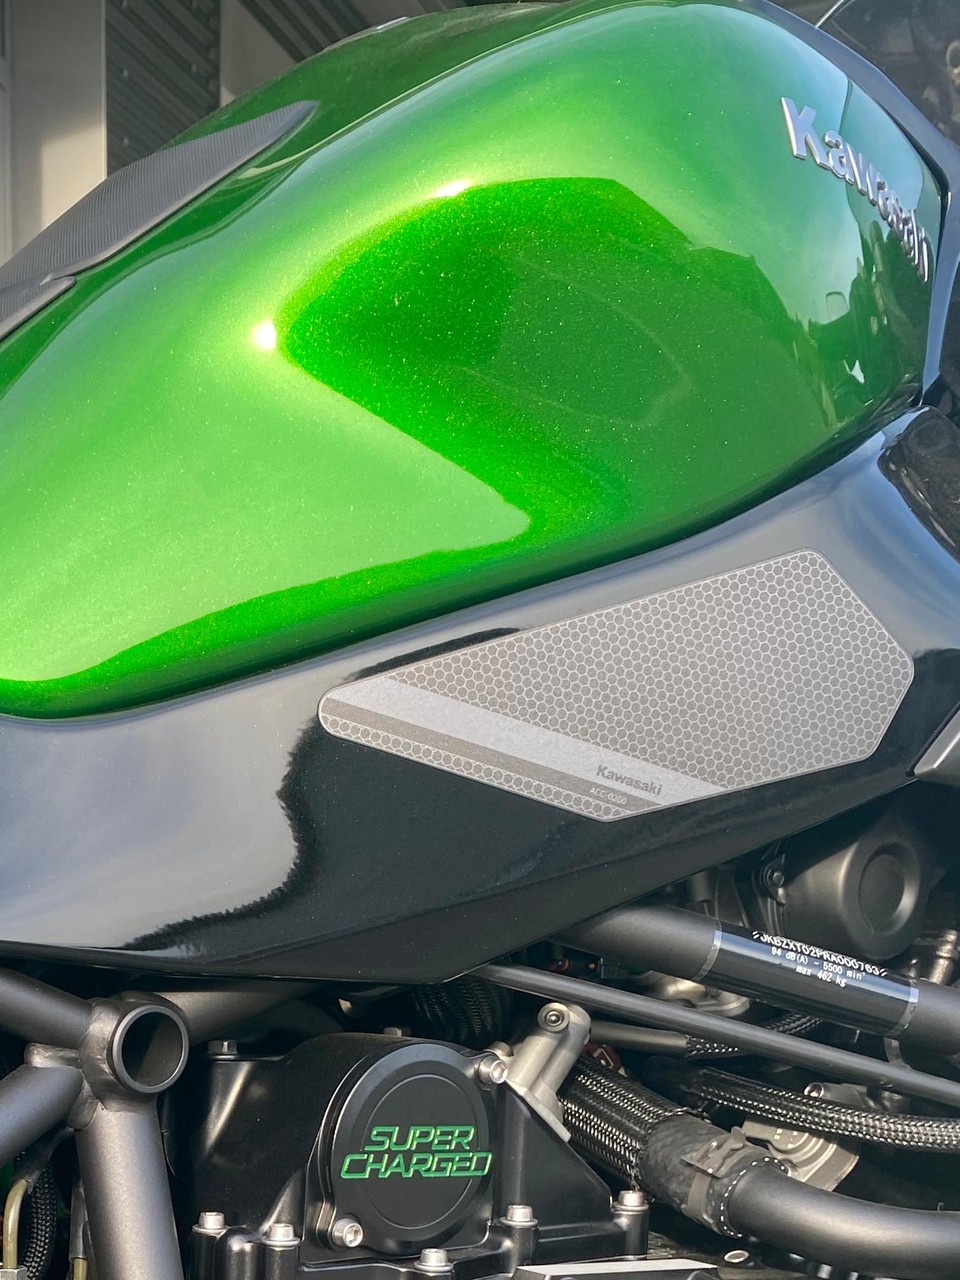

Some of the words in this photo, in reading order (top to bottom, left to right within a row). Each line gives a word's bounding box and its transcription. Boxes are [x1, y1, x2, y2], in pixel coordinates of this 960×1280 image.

[596, 765, 662, 796] Kawasaki
[589, 787, 627, 805] ACC-0200
[771, 946, 782, 956] 94
[785, 952, 809, 965] dB(A)
[823, 960, 843, 974] 5500
[795, 965, 812, 976] max
[817, 971, 832, 983] 462
[835, 976, 847, 988] kg
[364, 1125, 474, 1151] SUPER
[340, 1152, 492, 1179] CHARGED
